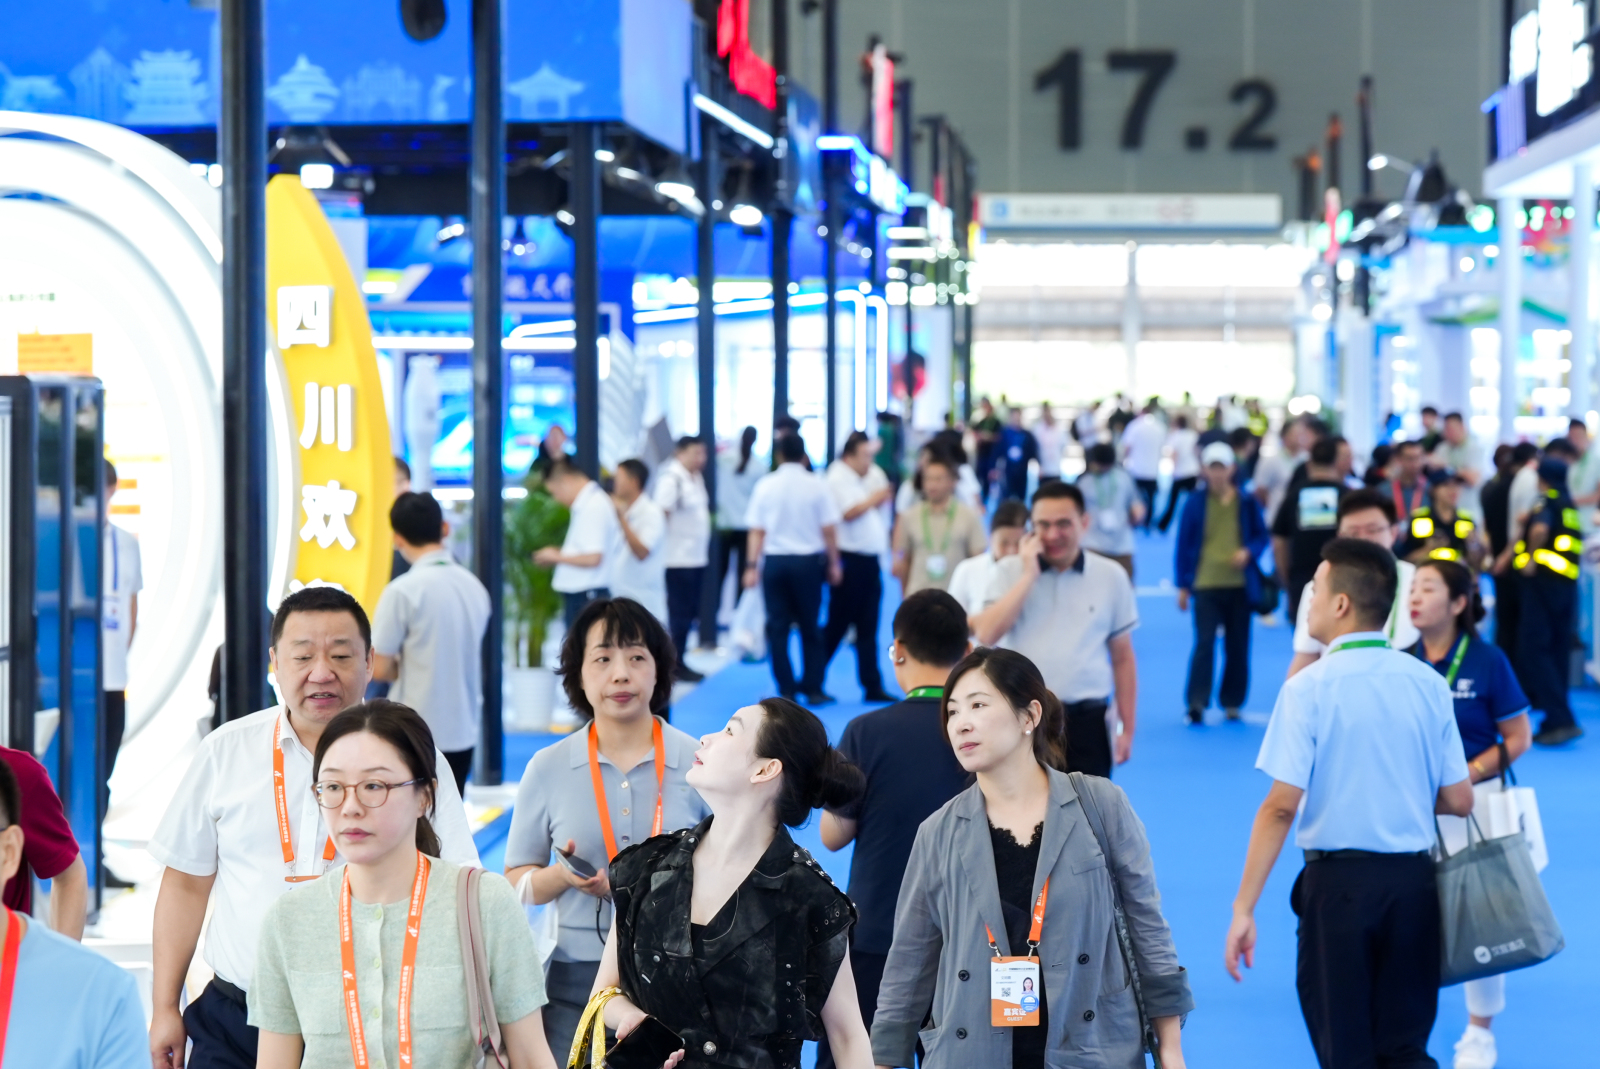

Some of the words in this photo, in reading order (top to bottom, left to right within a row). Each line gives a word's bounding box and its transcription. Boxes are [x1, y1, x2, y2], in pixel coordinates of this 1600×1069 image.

[1034, 47, 1279, 153] 17.2
[277, 285, 357, 592] 四川欢
